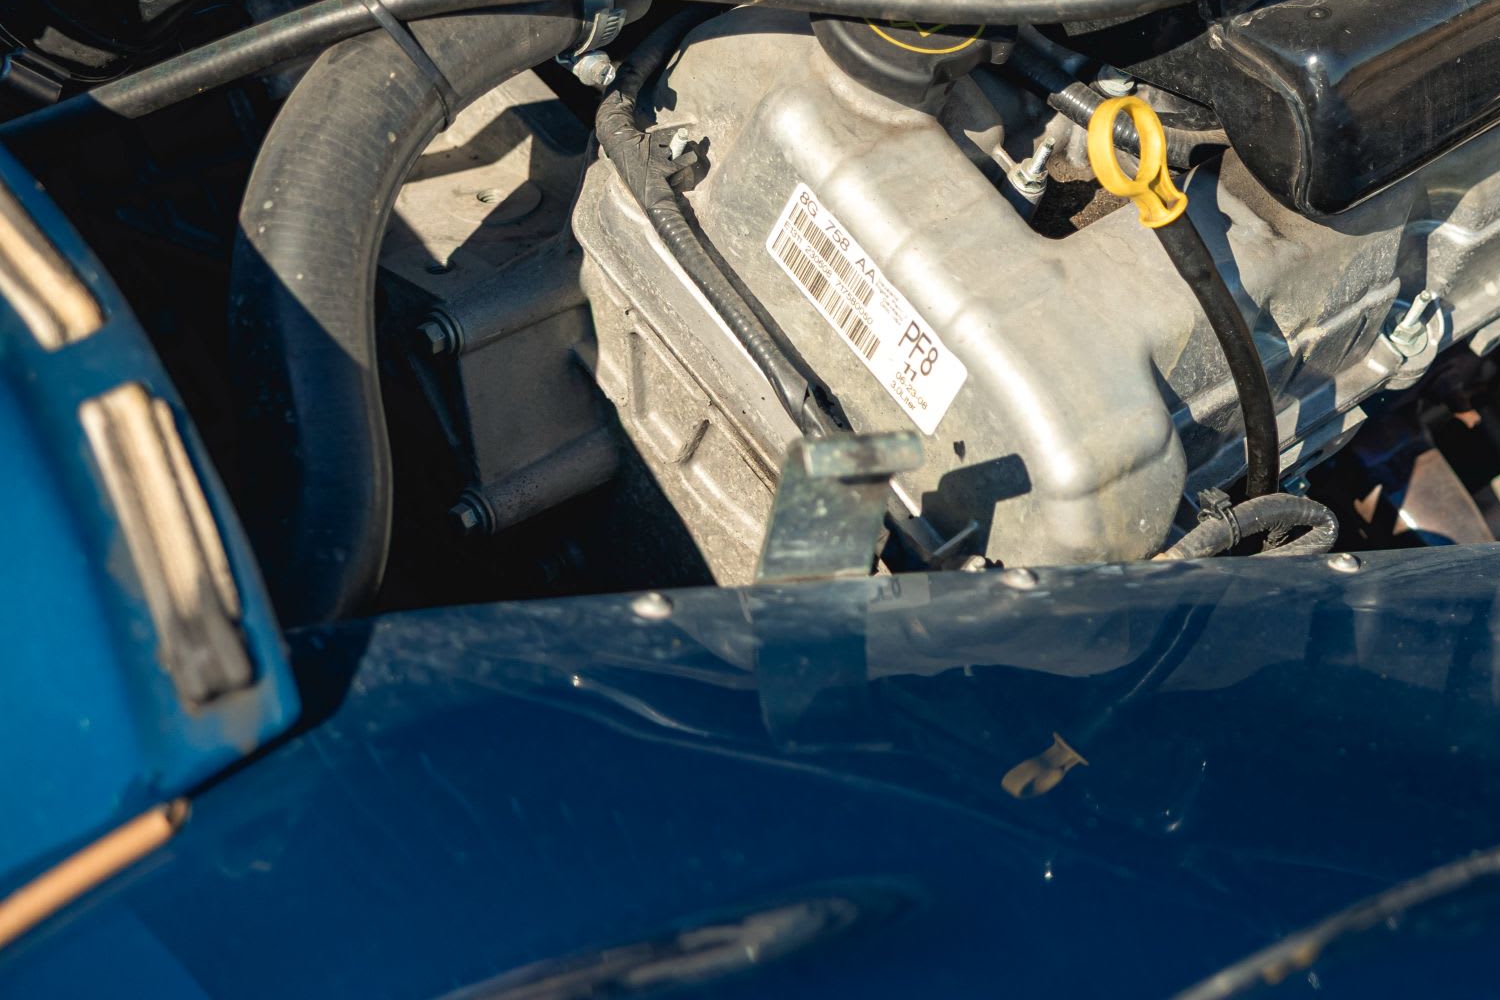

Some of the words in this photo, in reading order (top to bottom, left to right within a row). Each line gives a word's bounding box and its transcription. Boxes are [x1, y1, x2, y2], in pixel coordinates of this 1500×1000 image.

[799, 191, 818, 218] 8G
[824, 219, 850, 252] 758
[855, 258, 876, 284] AA
[898, 320, 939, 376] PF8
[896, 371, 929, 411] 06-23-08
